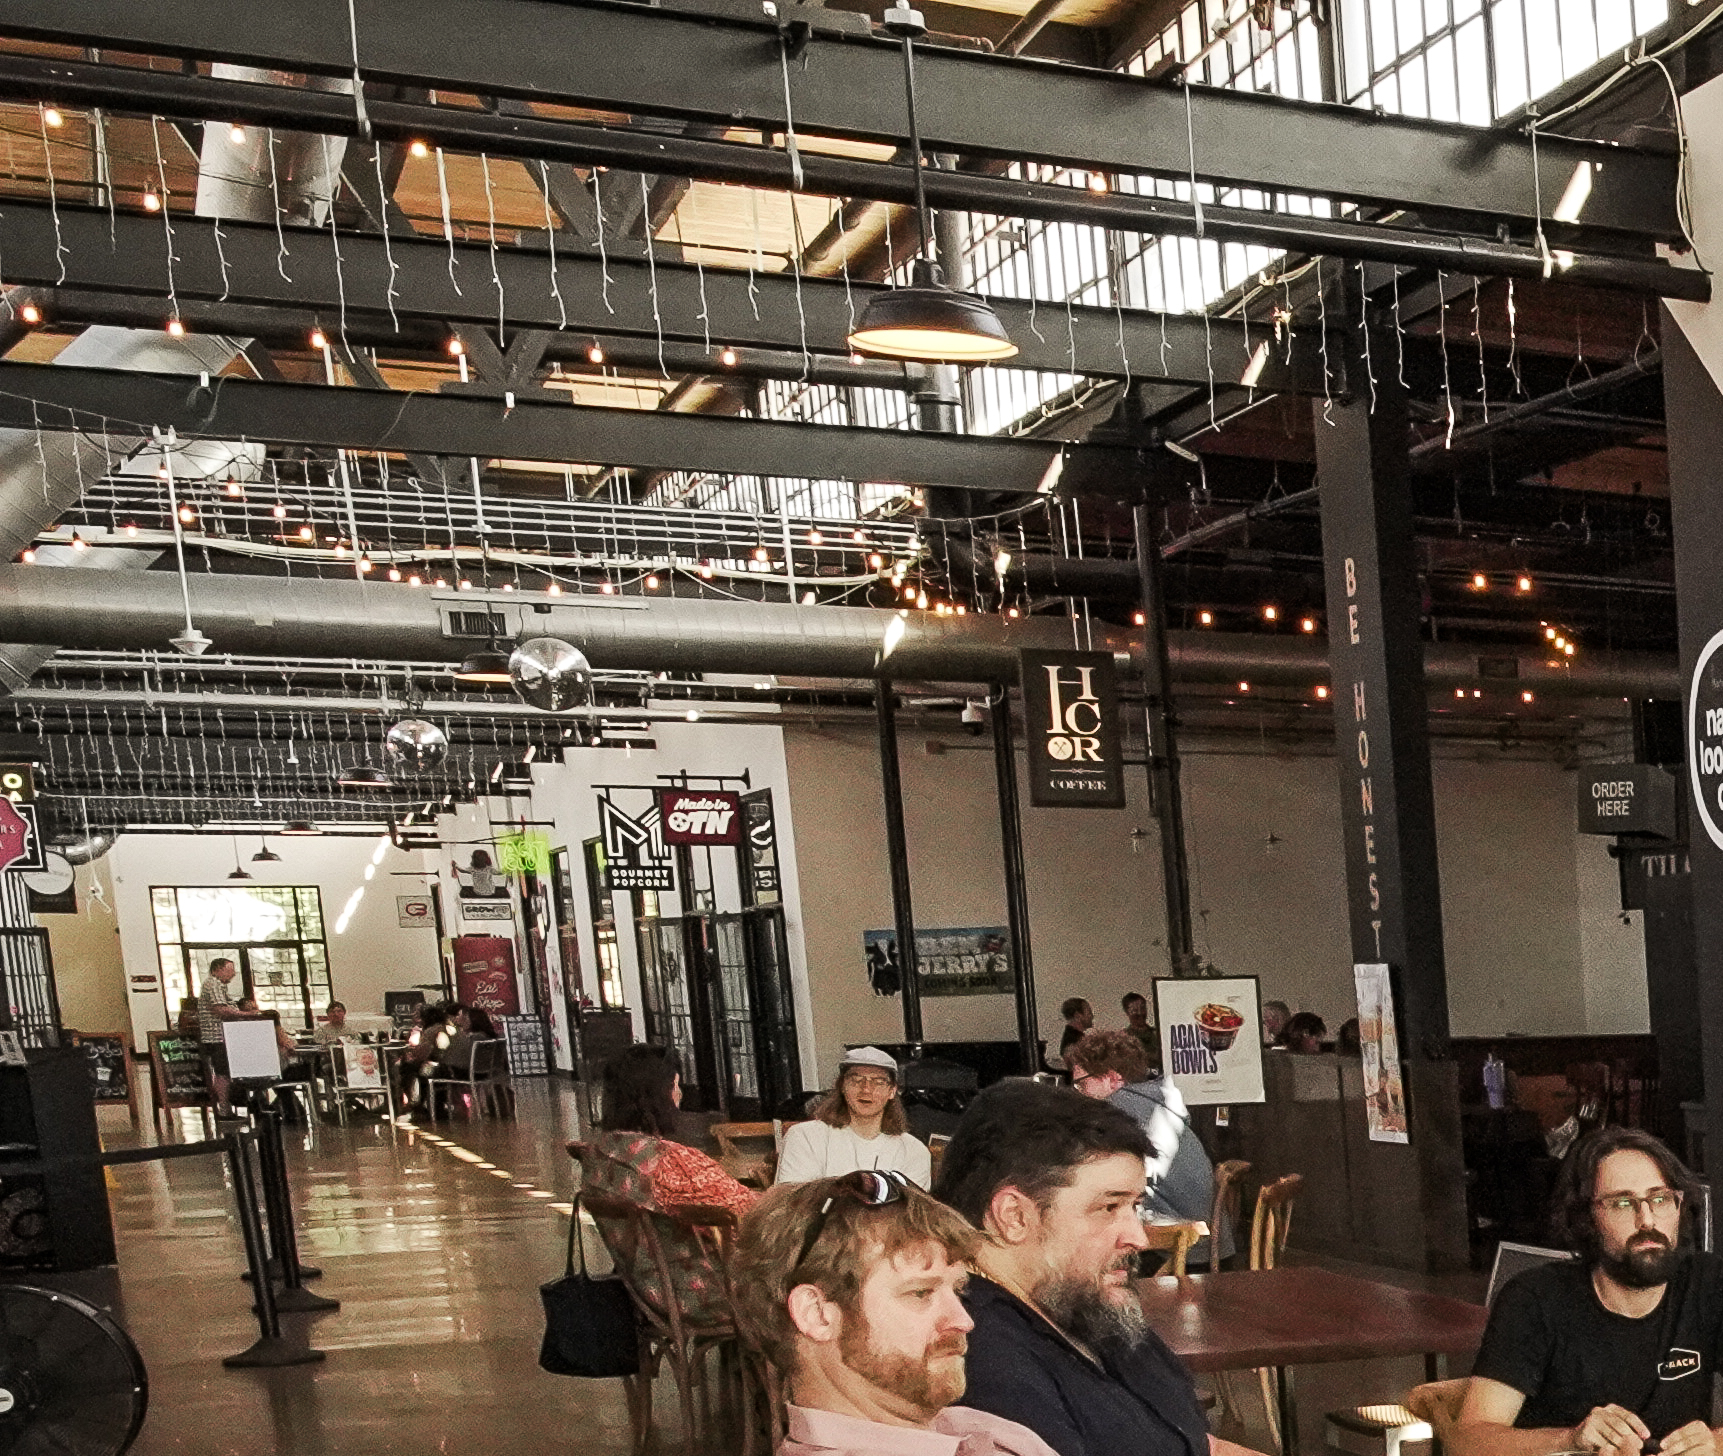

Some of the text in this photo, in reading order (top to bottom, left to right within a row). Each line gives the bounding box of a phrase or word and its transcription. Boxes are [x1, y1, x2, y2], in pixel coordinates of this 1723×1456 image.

[1344, 557, 1383, 959] BE HONEST
[1050, 779, 1106, 790] COFFEE
[1592, 781, 1634, 798] ORDER
[673, 797, 730, 810] Made in
[1597, 800, 1630, 816] HERE
[611, 869, 668, 878] GOURMET
[613, 878, 669, 887] POPCORN
[917, 952, 1008, 975] JERRY'S
[1171, 1049, 1218, 1074] BOWLS
